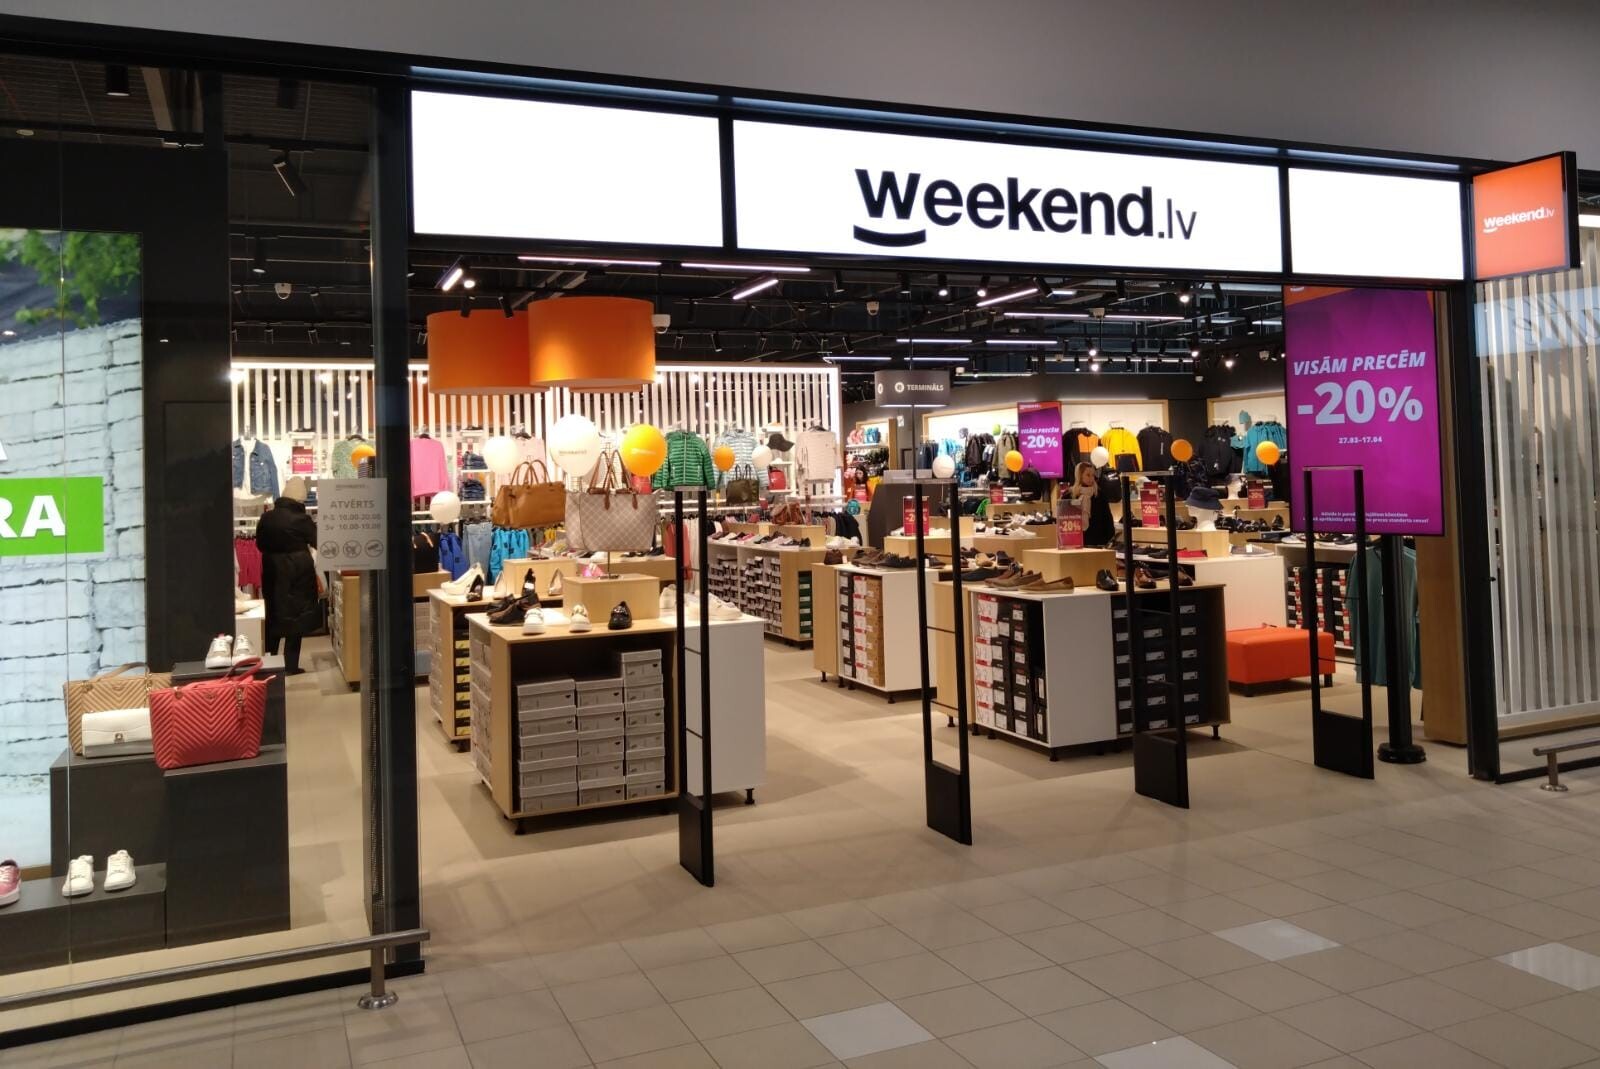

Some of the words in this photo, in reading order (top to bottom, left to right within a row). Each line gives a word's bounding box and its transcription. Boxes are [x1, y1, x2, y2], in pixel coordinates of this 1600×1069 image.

[1483, 206, 1556, 230] weekend.lv
[1293, 355, 1348, 376] VISĀM
[1351, 349, 1427, 372] PRECĒM
[906, 382, 944, 391] TERMINĀLS
[1297, 379, 1424, 425] -20%
[1021, 434, 1059, 449] -20%
[329, 498, 376, 509] ATVĒRTS
[1058, 519, 1082, 532] -20%
